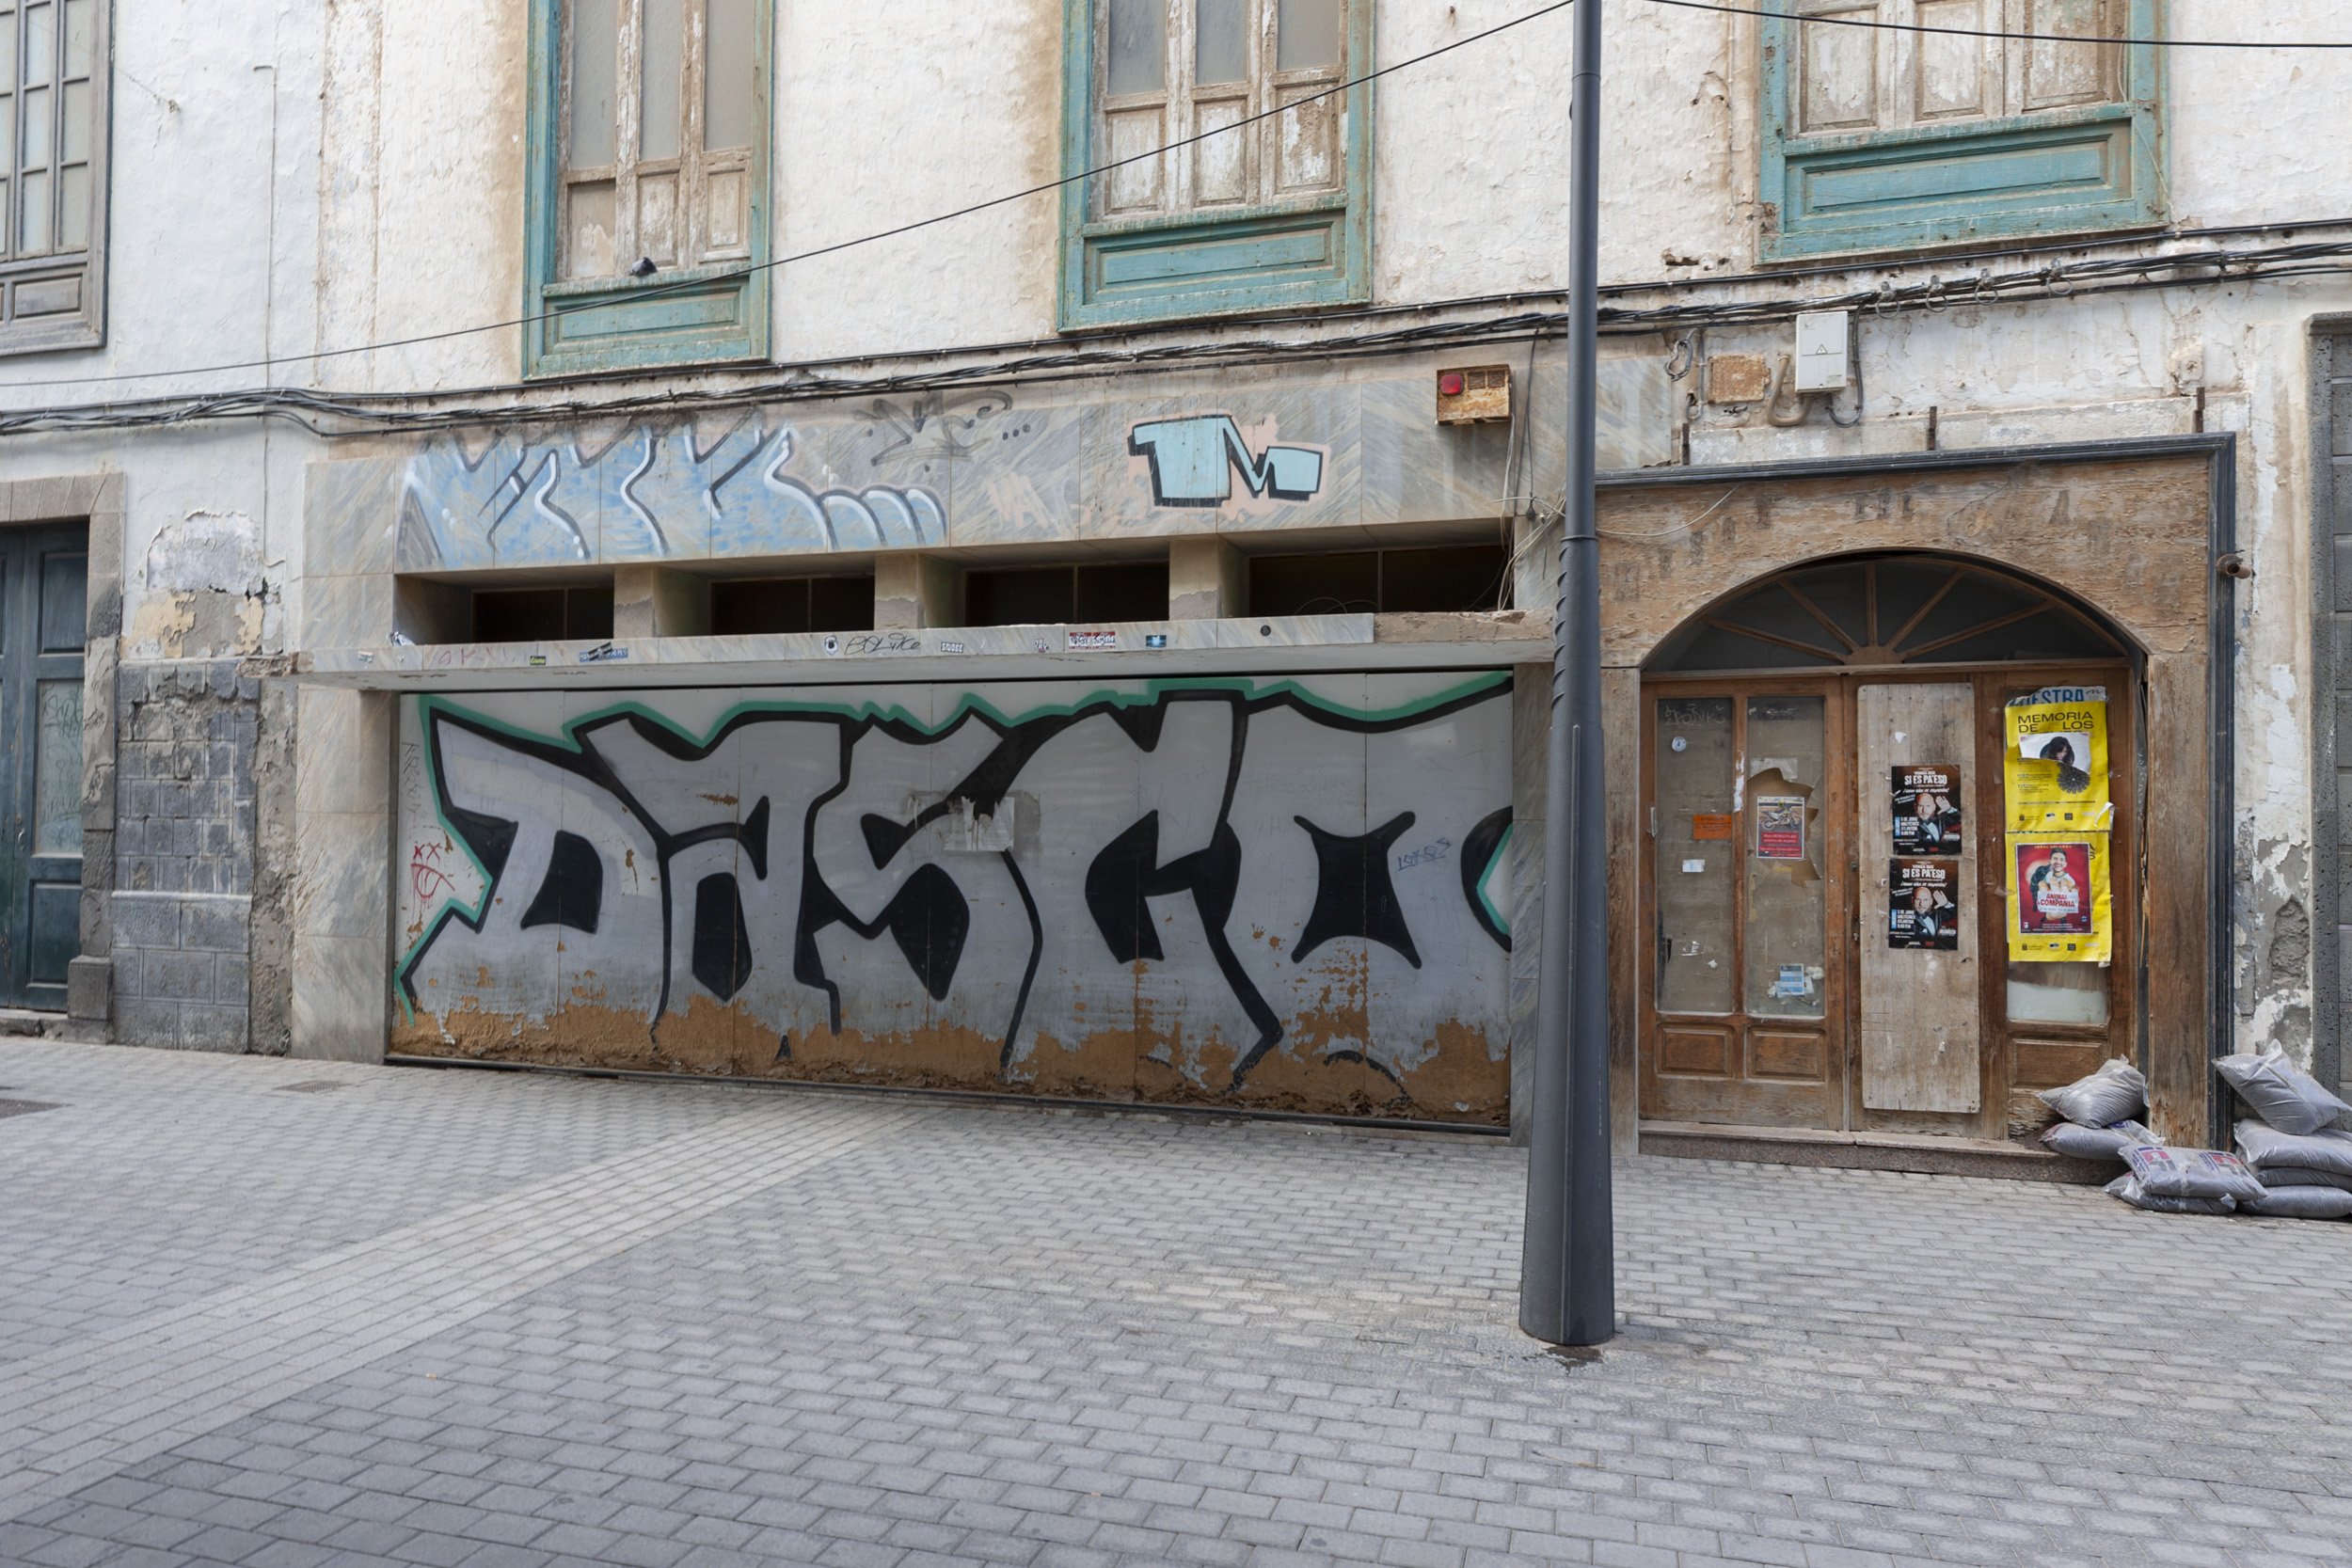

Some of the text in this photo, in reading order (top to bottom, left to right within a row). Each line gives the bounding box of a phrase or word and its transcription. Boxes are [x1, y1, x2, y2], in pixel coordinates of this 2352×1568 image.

[2018, 711, 2093, 723] MEMORIA
[2018, 721, 2094, 733] DE LOS
[1904, 775, 1912, 785] SI
[1913, 775, 1922, 784] ES
[1902, 869, 1910, 879] SI
[1911, 869, 1920, 878] ES
